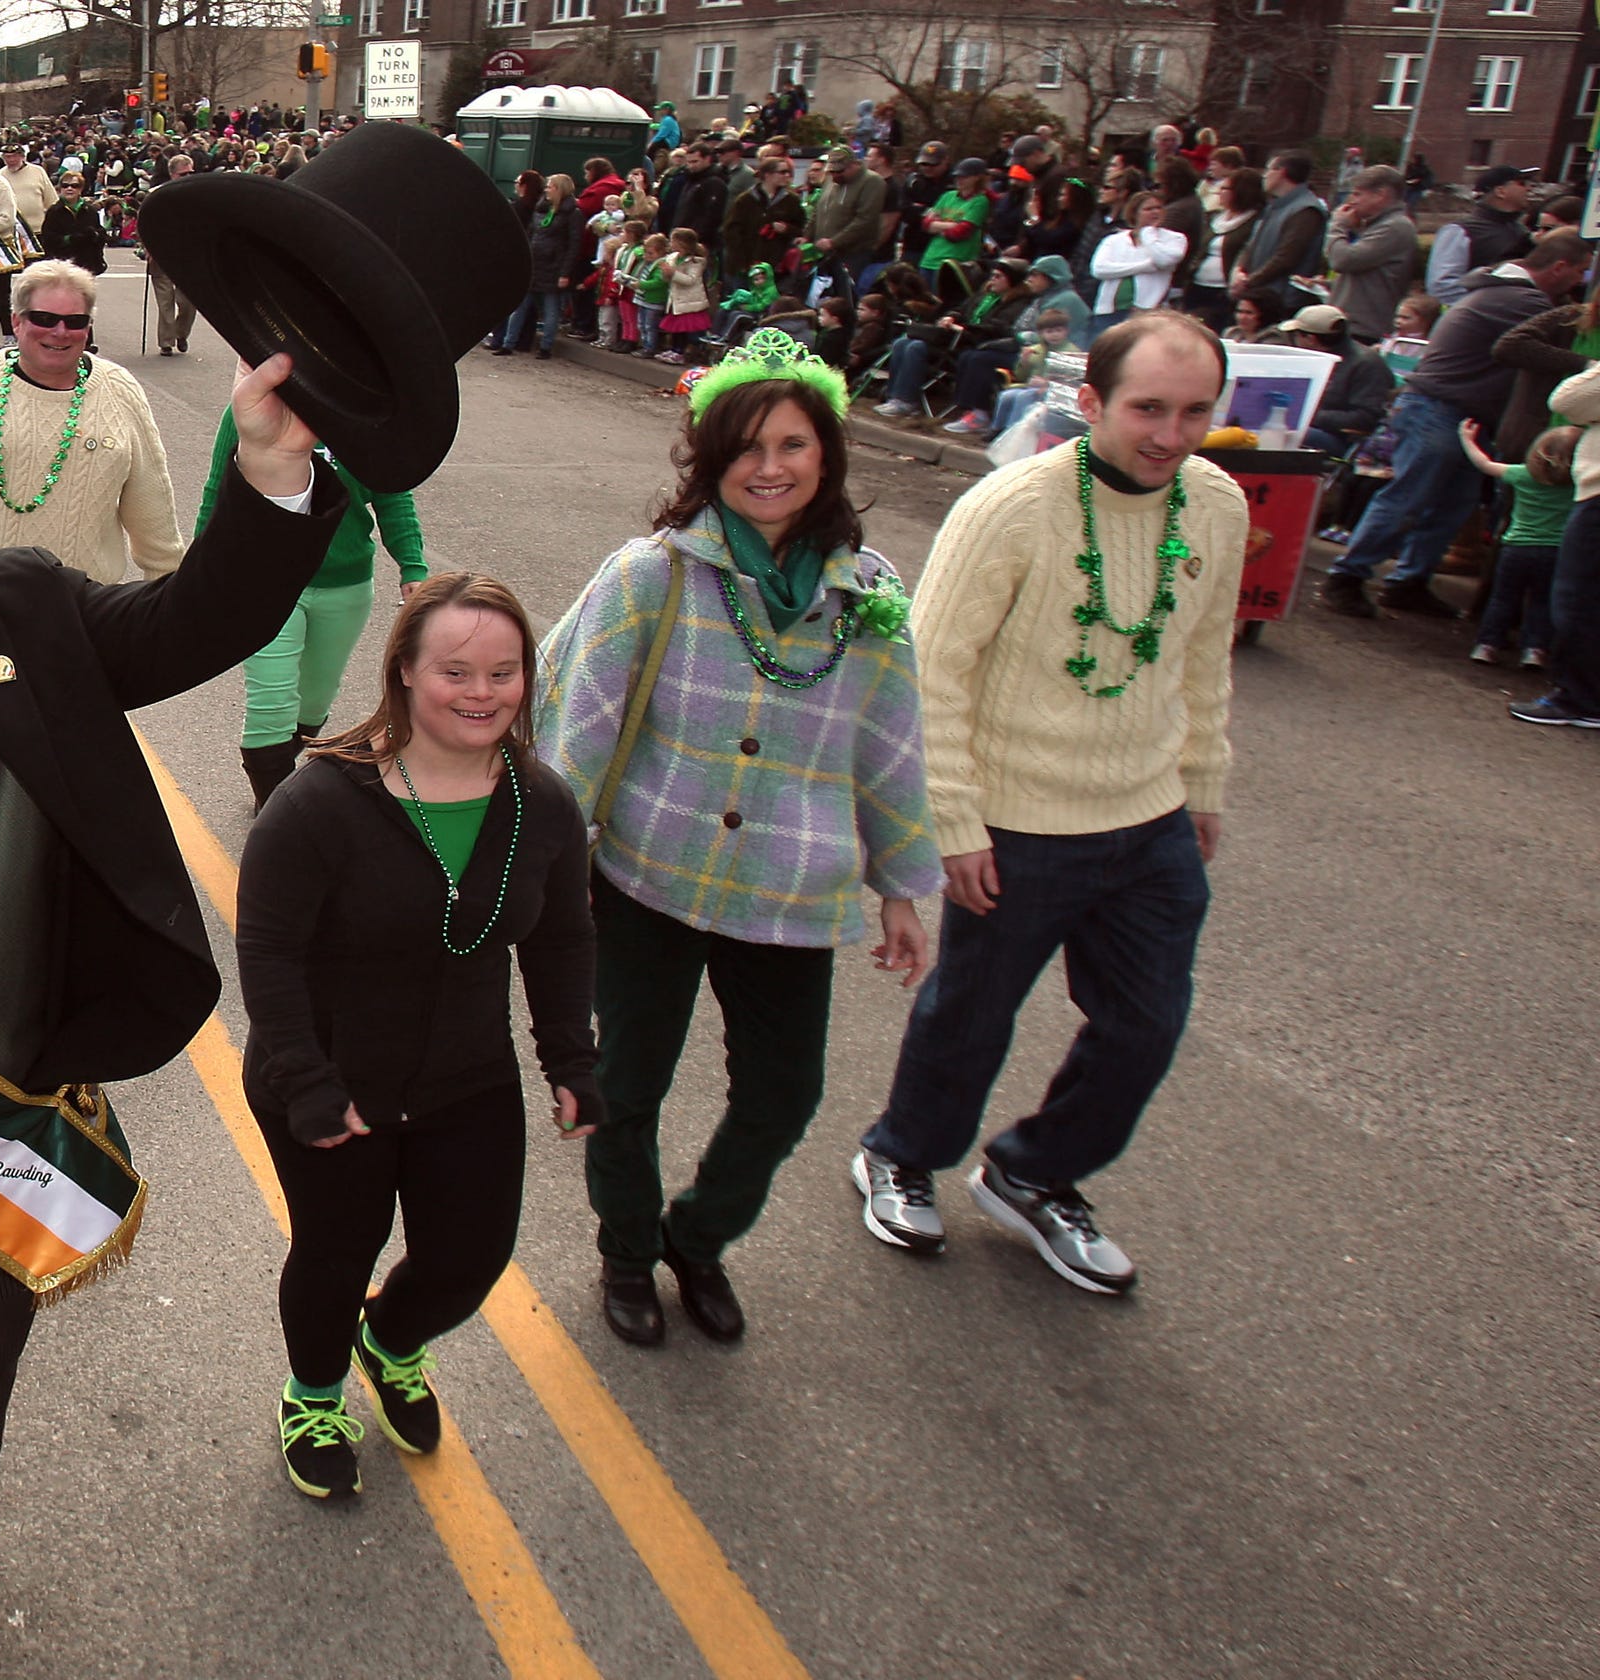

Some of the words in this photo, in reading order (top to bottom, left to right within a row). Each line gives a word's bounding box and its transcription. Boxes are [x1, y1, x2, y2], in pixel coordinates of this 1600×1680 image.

[382, 47, 404, 57] NO
[377, 60, 410, 71] TURN
[370, 75, 387, 85] ON
[393, 73, 416, 84] RED
[370, 95, 415, 108] 9AM-9PM
